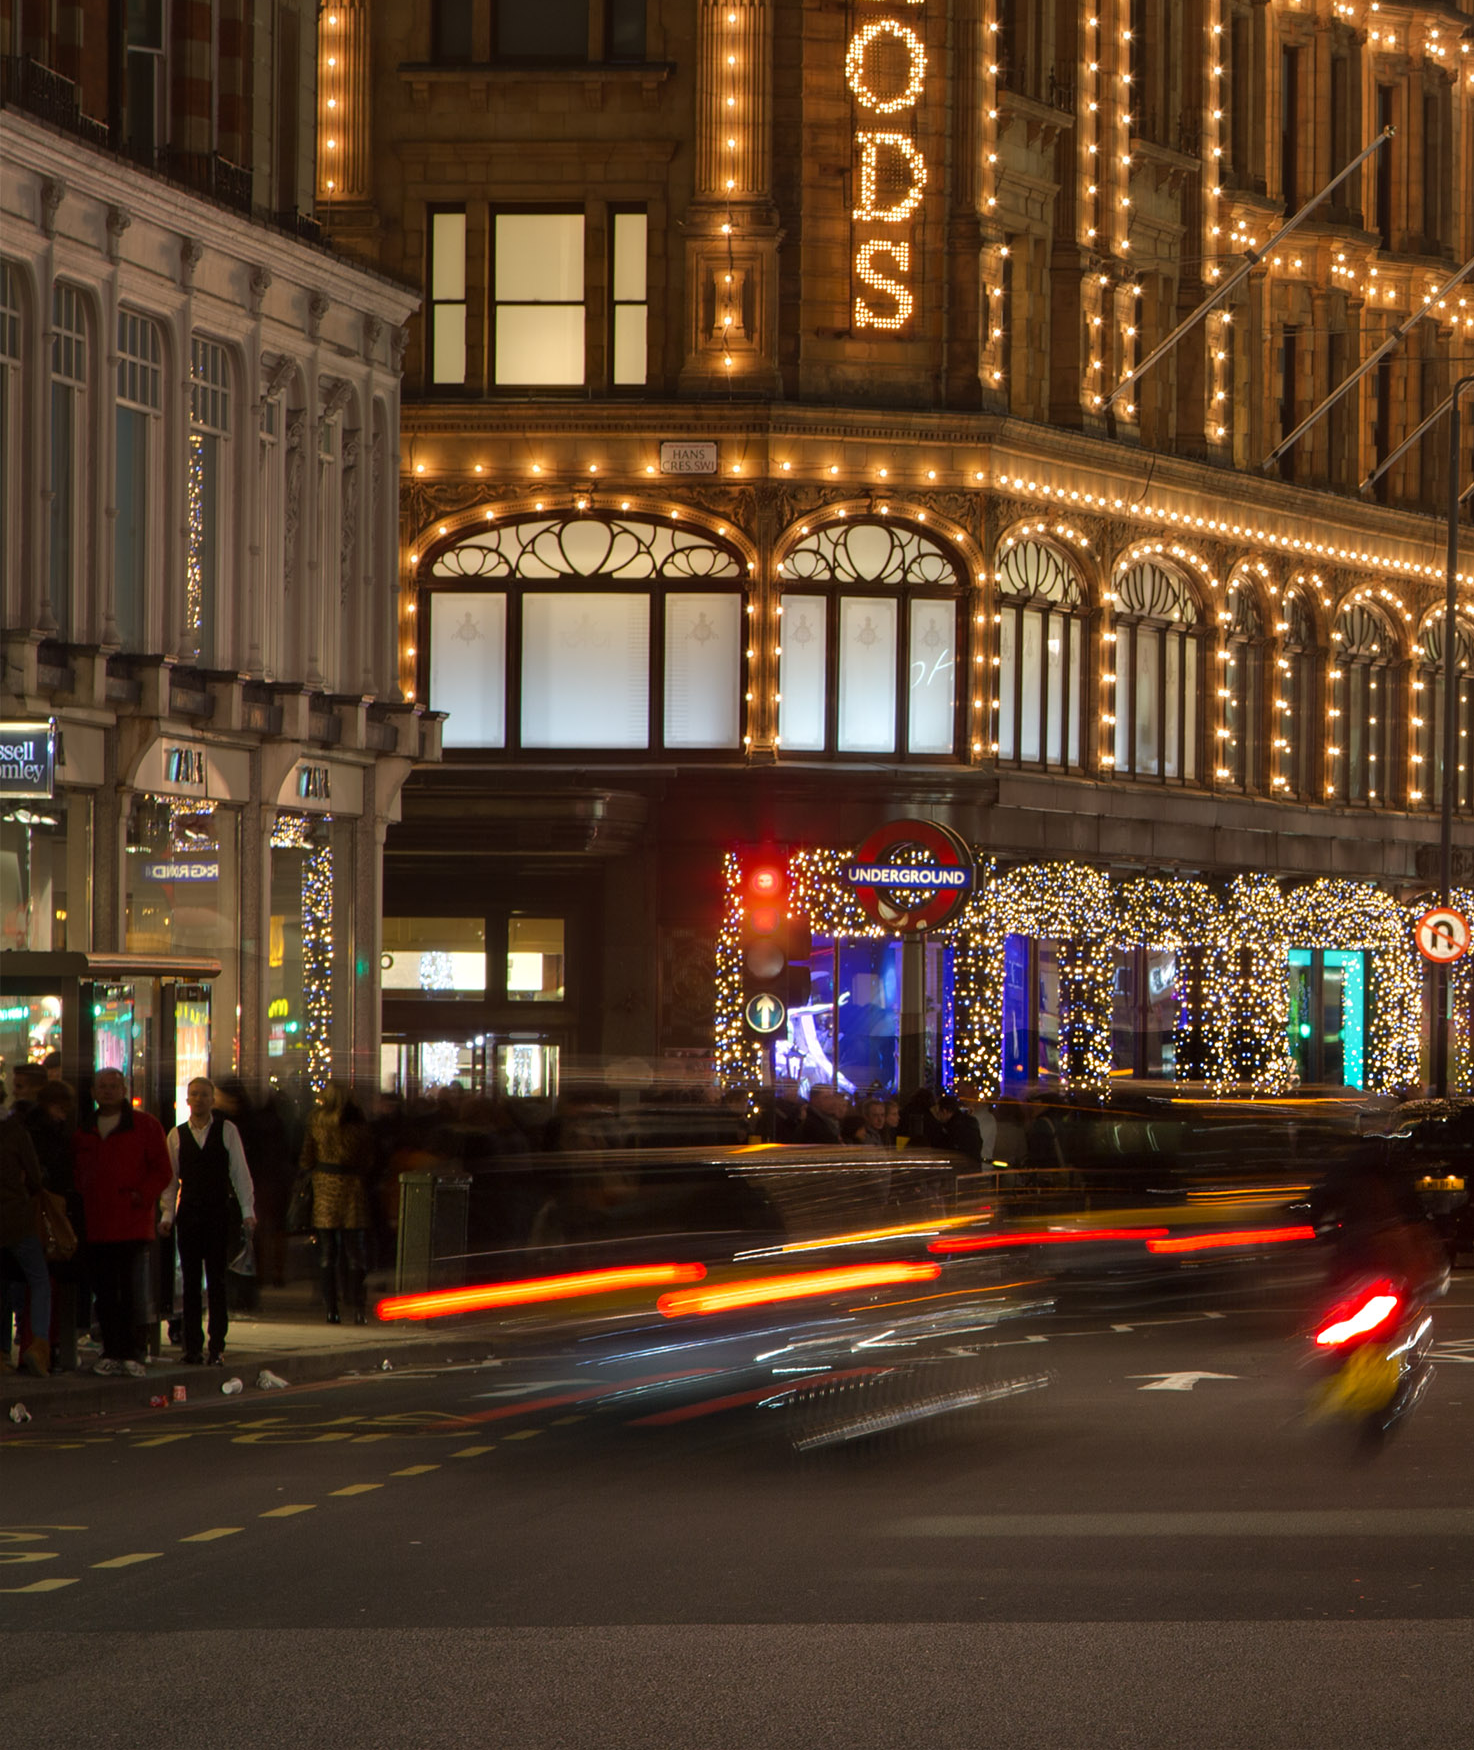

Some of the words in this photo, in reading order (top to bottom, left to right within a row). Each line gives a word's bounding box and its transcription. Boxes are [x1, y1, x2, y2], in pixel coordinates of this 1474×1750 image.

[672, 449, 705, 460] HANS
[0, 761, 44, 783] mley
[848, 868, 966, 885] UNDERGROUND
